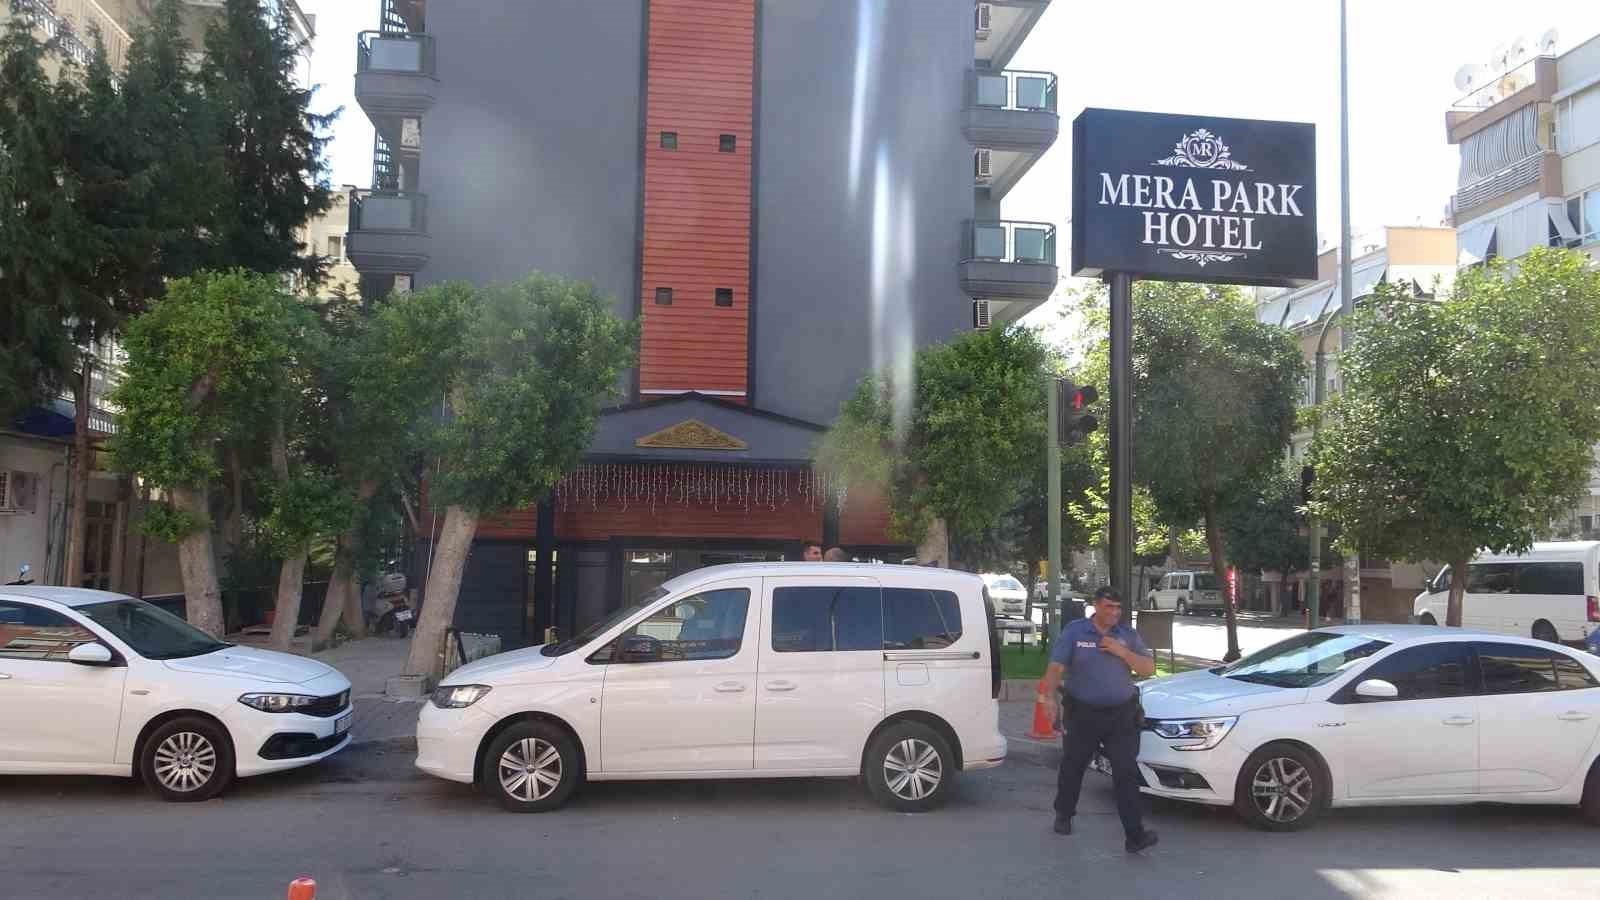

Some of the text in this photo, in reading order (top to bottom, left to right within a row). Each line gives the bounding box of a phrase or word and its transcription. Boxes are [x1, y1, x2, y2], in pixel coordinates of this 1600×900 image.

[1099, 172, 1304, 217] MERA PARK
[1141, 211, 1263, 250] HOTEL
